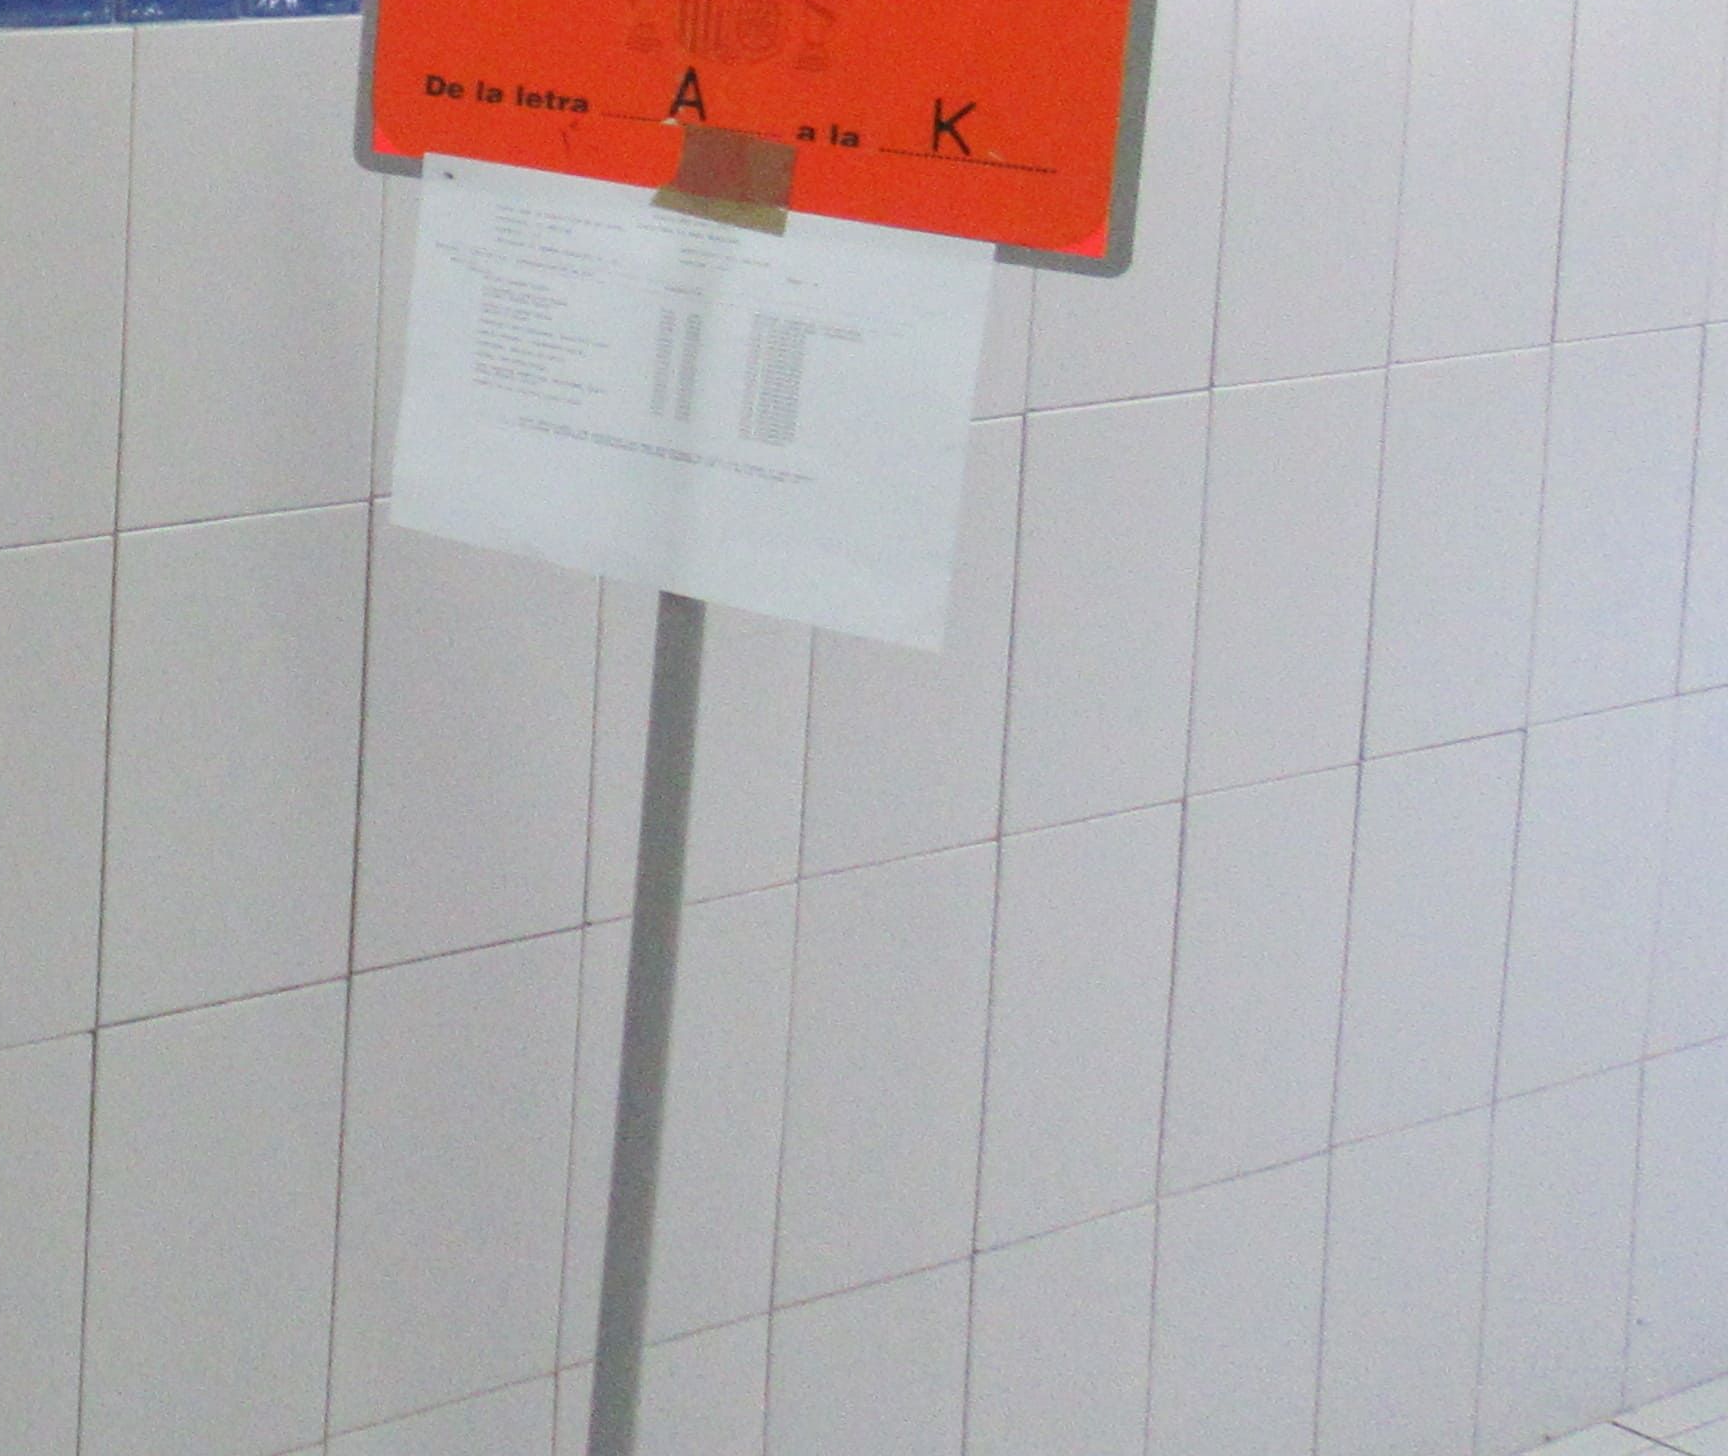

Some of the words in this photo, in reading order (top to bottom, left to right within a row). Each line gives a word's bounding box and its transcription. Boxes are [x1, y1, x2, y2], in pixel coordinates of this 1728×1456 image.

[424, 73, 464, 100] De
[475, 79, 504, 105] la
[516, 85, 590, 115] letra
[668, 65, 707, 122] A
[796, 121, 817, 143] a
[829, 123, 861, 149] la
[931, 97, 978, 157] K
